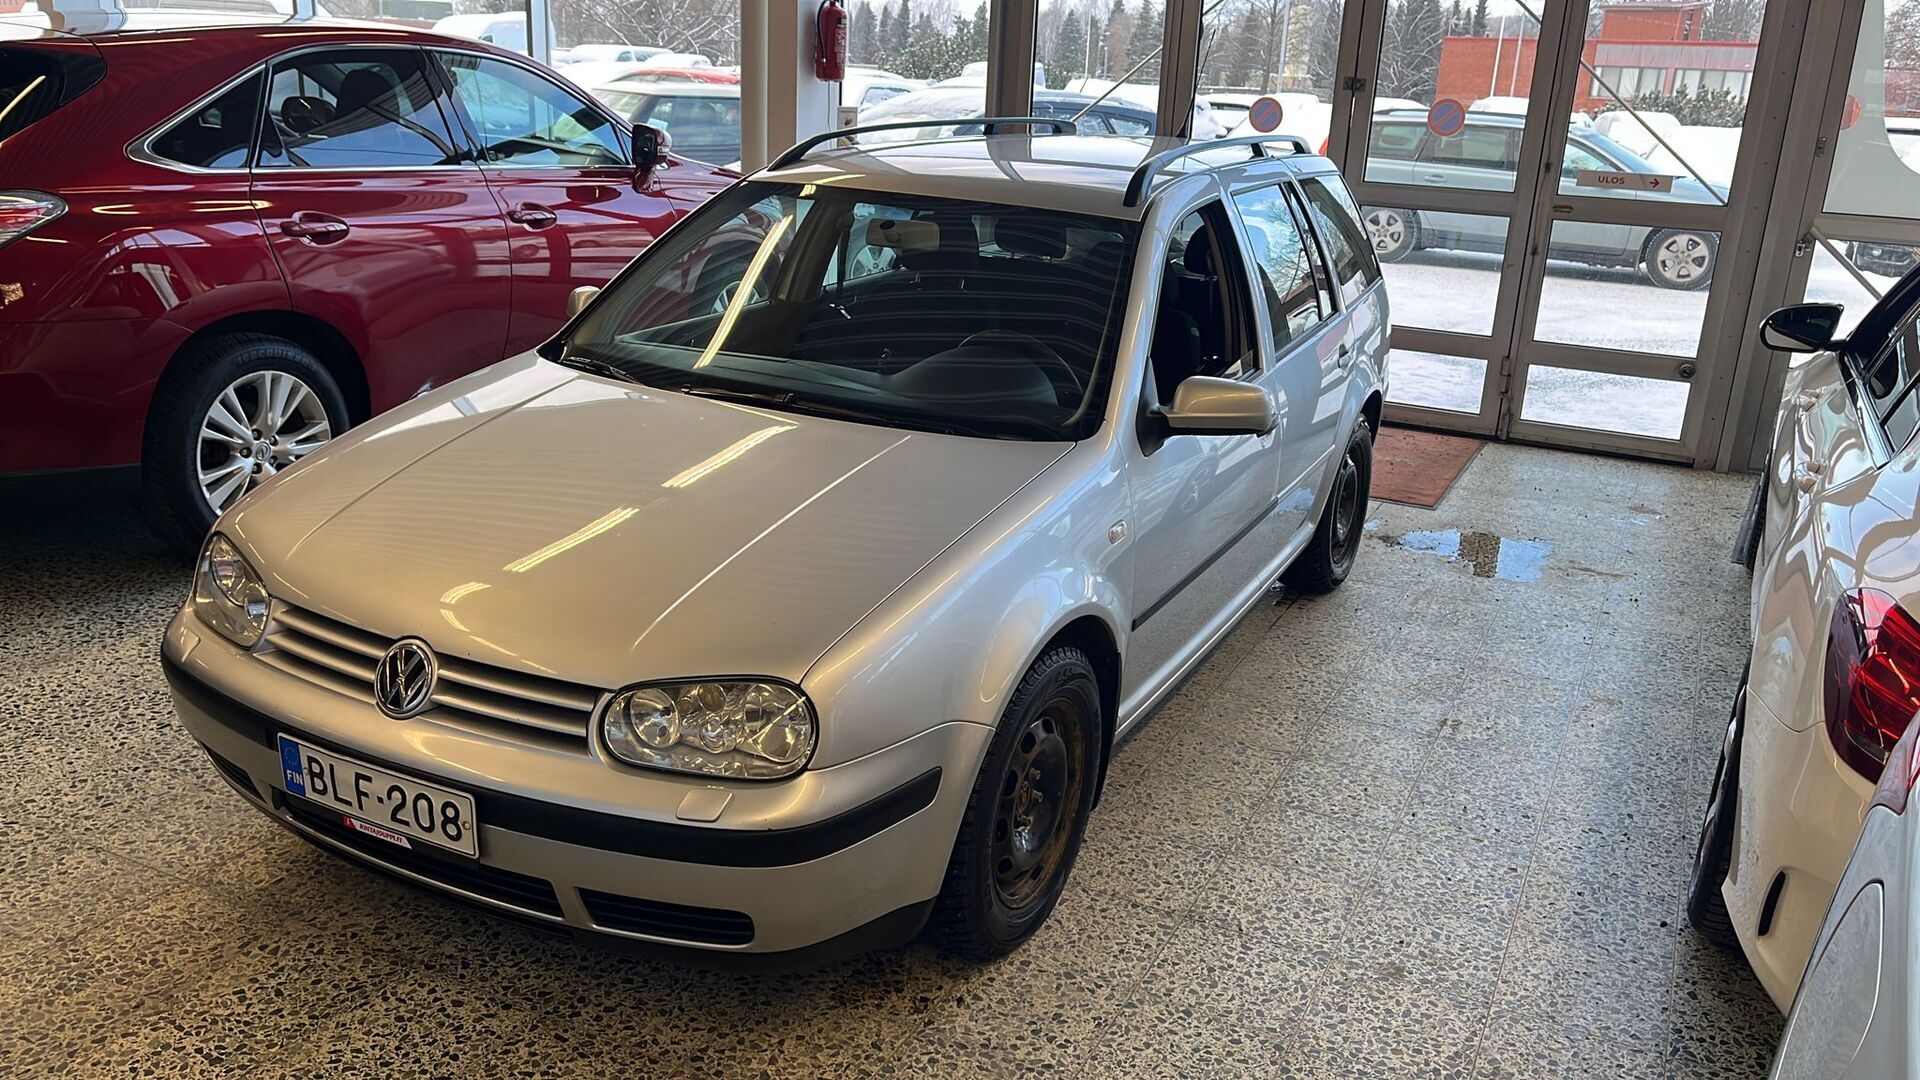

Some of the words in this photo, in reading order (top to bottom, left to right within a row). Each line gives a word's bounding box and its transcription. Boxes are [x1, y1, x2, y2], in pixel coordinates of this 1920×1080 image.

[1598, 176, 1625, 185] ULOS
[287, 769, 304, 786] FIN
[306, 755, 463, 841] BLF-208
